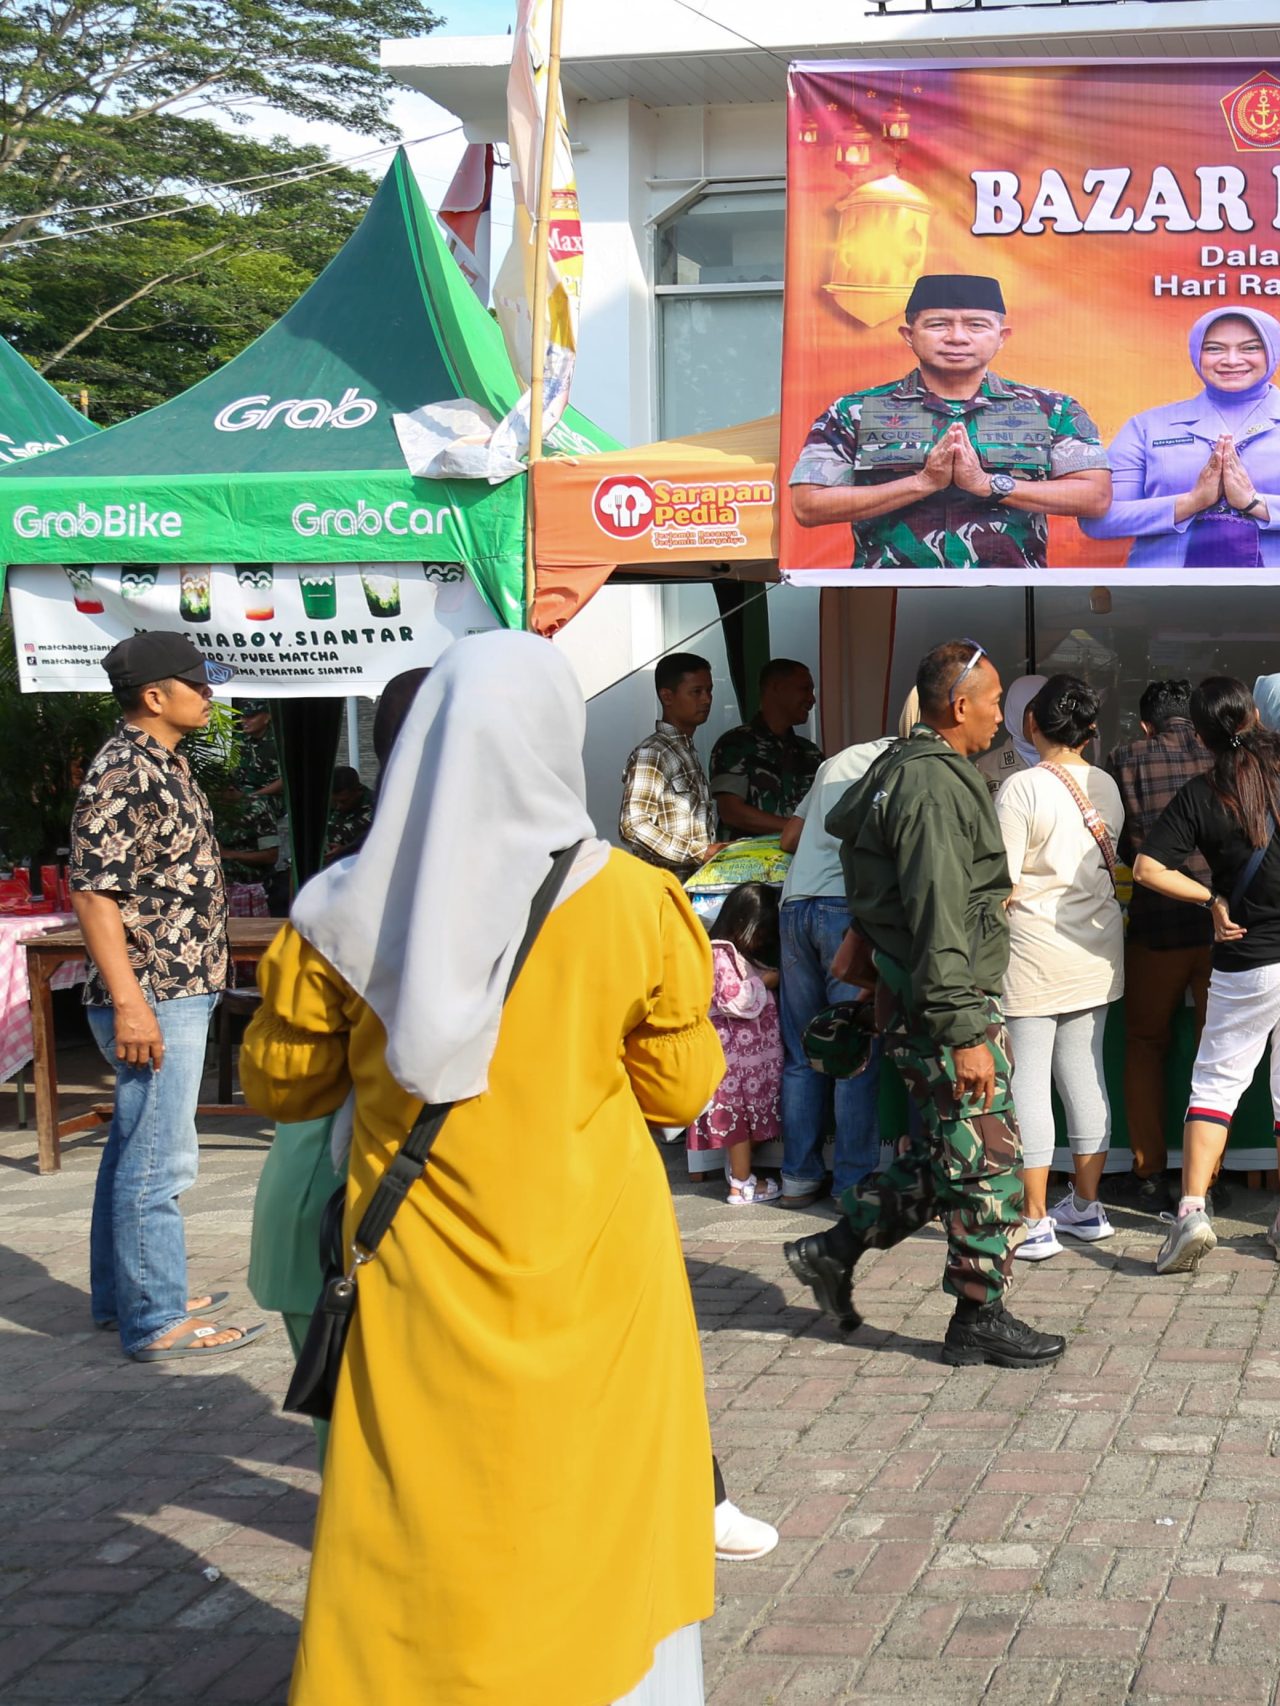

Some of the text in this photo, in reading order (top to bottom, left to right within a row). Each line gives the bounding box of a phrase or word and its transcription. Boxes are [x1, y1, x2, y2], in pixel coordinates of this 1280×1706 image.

[971, 165, 1253, 235] BAZAR
[1154, 273, 1226, 297] Hari
[213, 387, 378, 433] Grab
[867, 430, 922, 442] AGUS
[982, 431, 1046, 442] TNI AD
[653, 483, 771, 508] Sarapan
[13, 502, 182, 539] GrabBike
[291, 499, 450, 537] GrabCar
[653, 504, 736, 526] Pedia
[38, 643, 115, 653] matchaboy.siant
[241, 651, 276, 663] PURE
[279, 650, 340, 663] MATCHA
[260, 667, 315, 677] PEMATANG
[318, 665, 364, 675] SIANTAR
